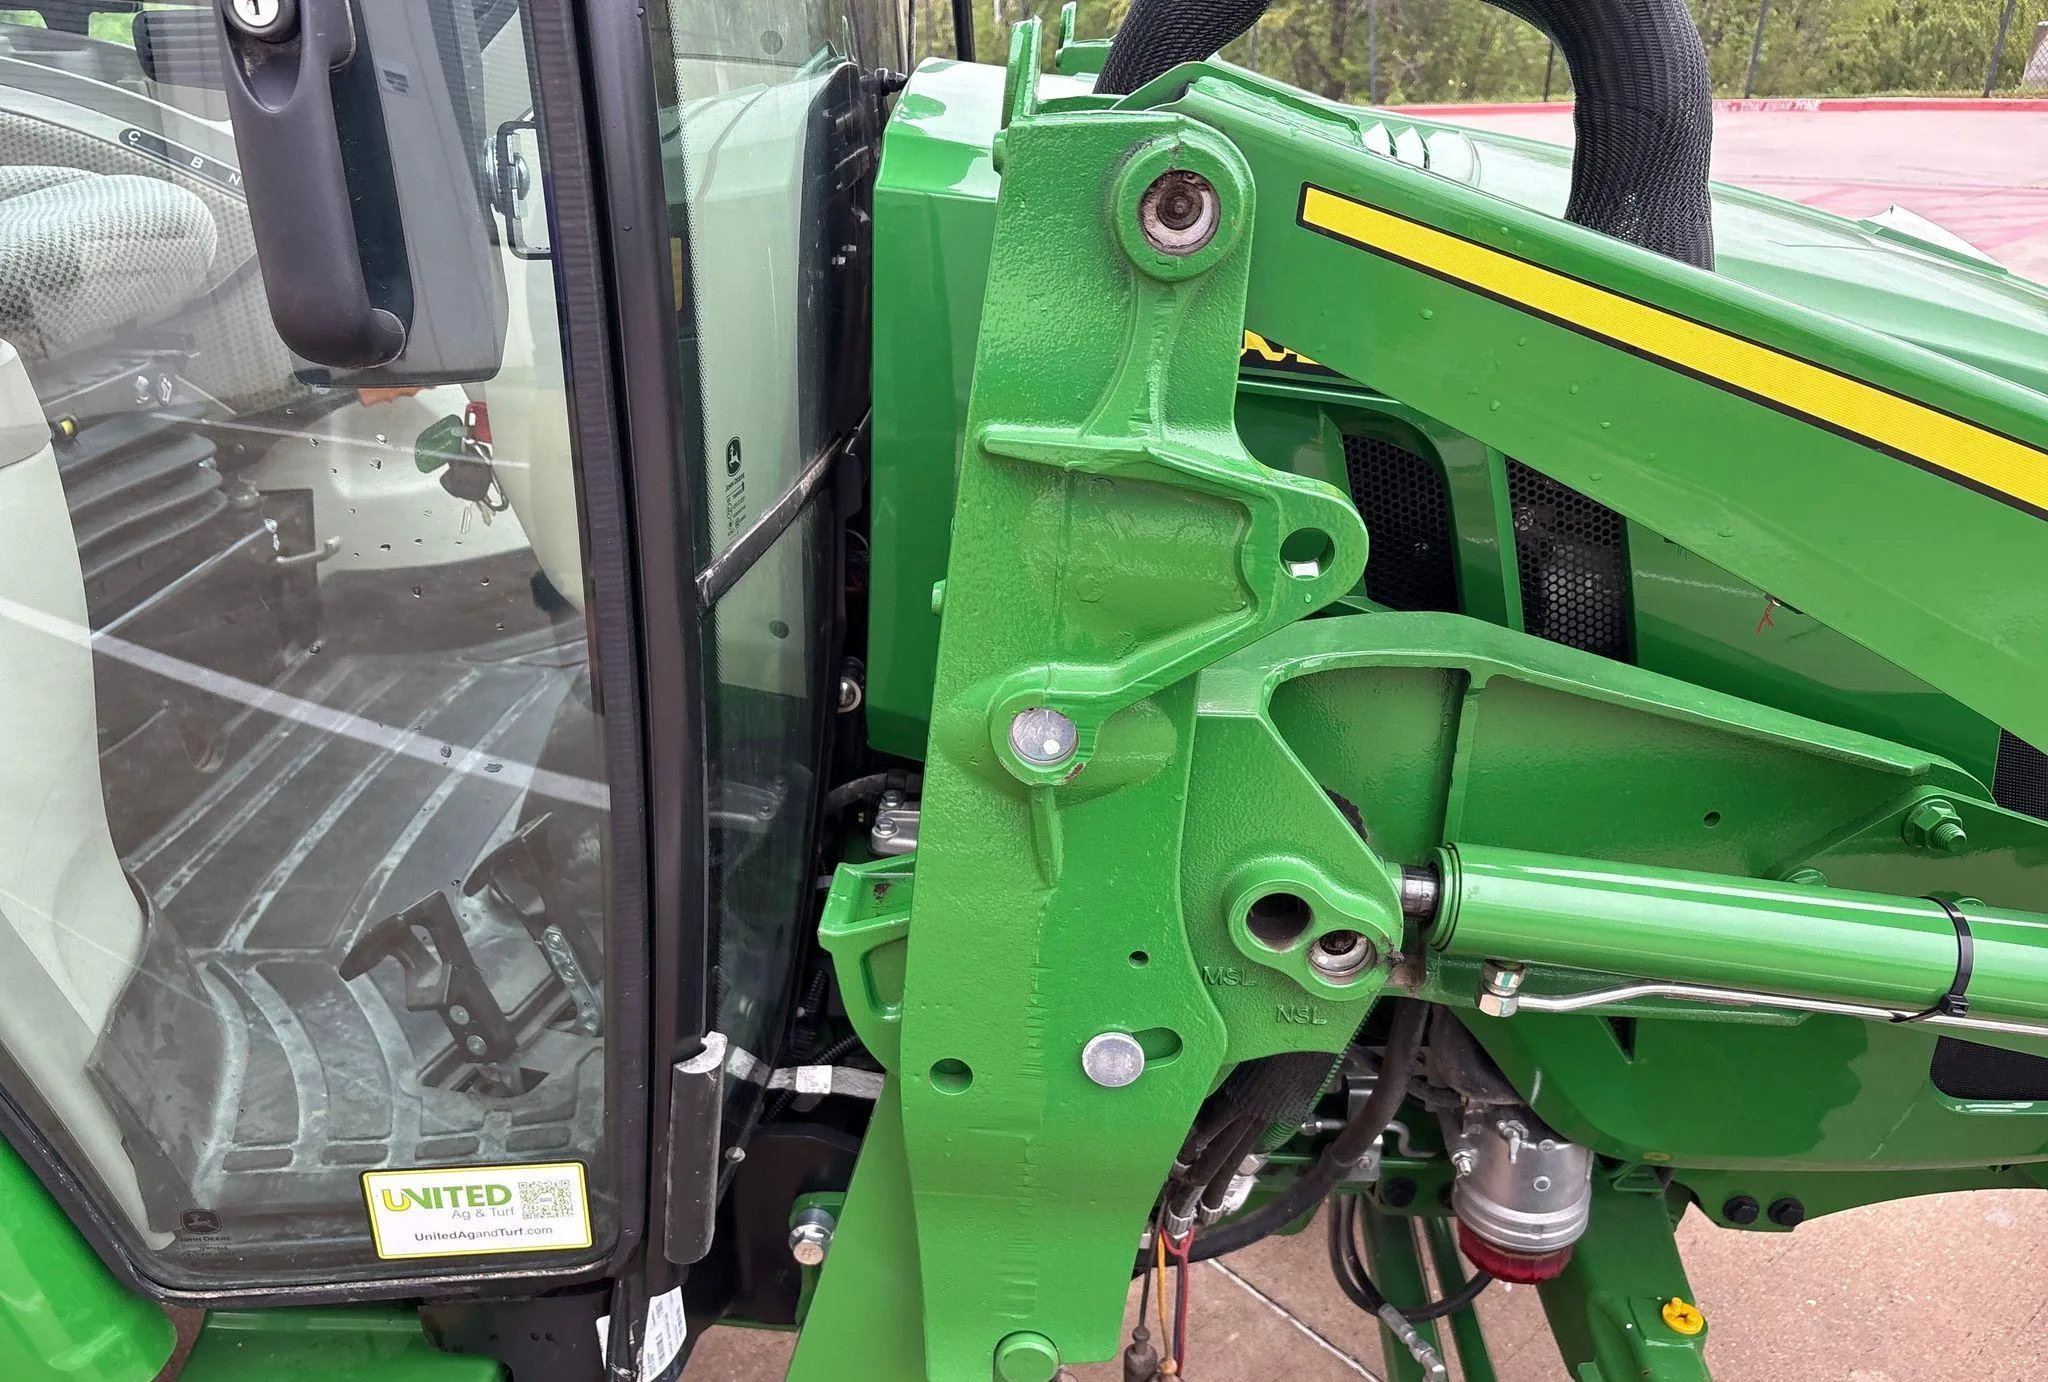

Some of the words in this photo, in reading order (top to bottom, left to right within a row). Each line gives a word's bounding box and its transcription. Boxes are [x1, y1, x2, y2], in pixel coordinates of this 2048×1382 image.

[128, 131, 141, 142] C
[190, 156, 204, 169] B
[1202, 965, 1256, 987] MSL
[1276, 1004, 1327, 1025] NSL
[382, 1183, 513, 1212] UNITED
[451, 1208, 472, 1221] Ag
[475, 1208, 487, 1218] &
[491, 1206, 516, 1217] Turf
[414, 1226, 553, 1242] UnitedAgandTurf.com
